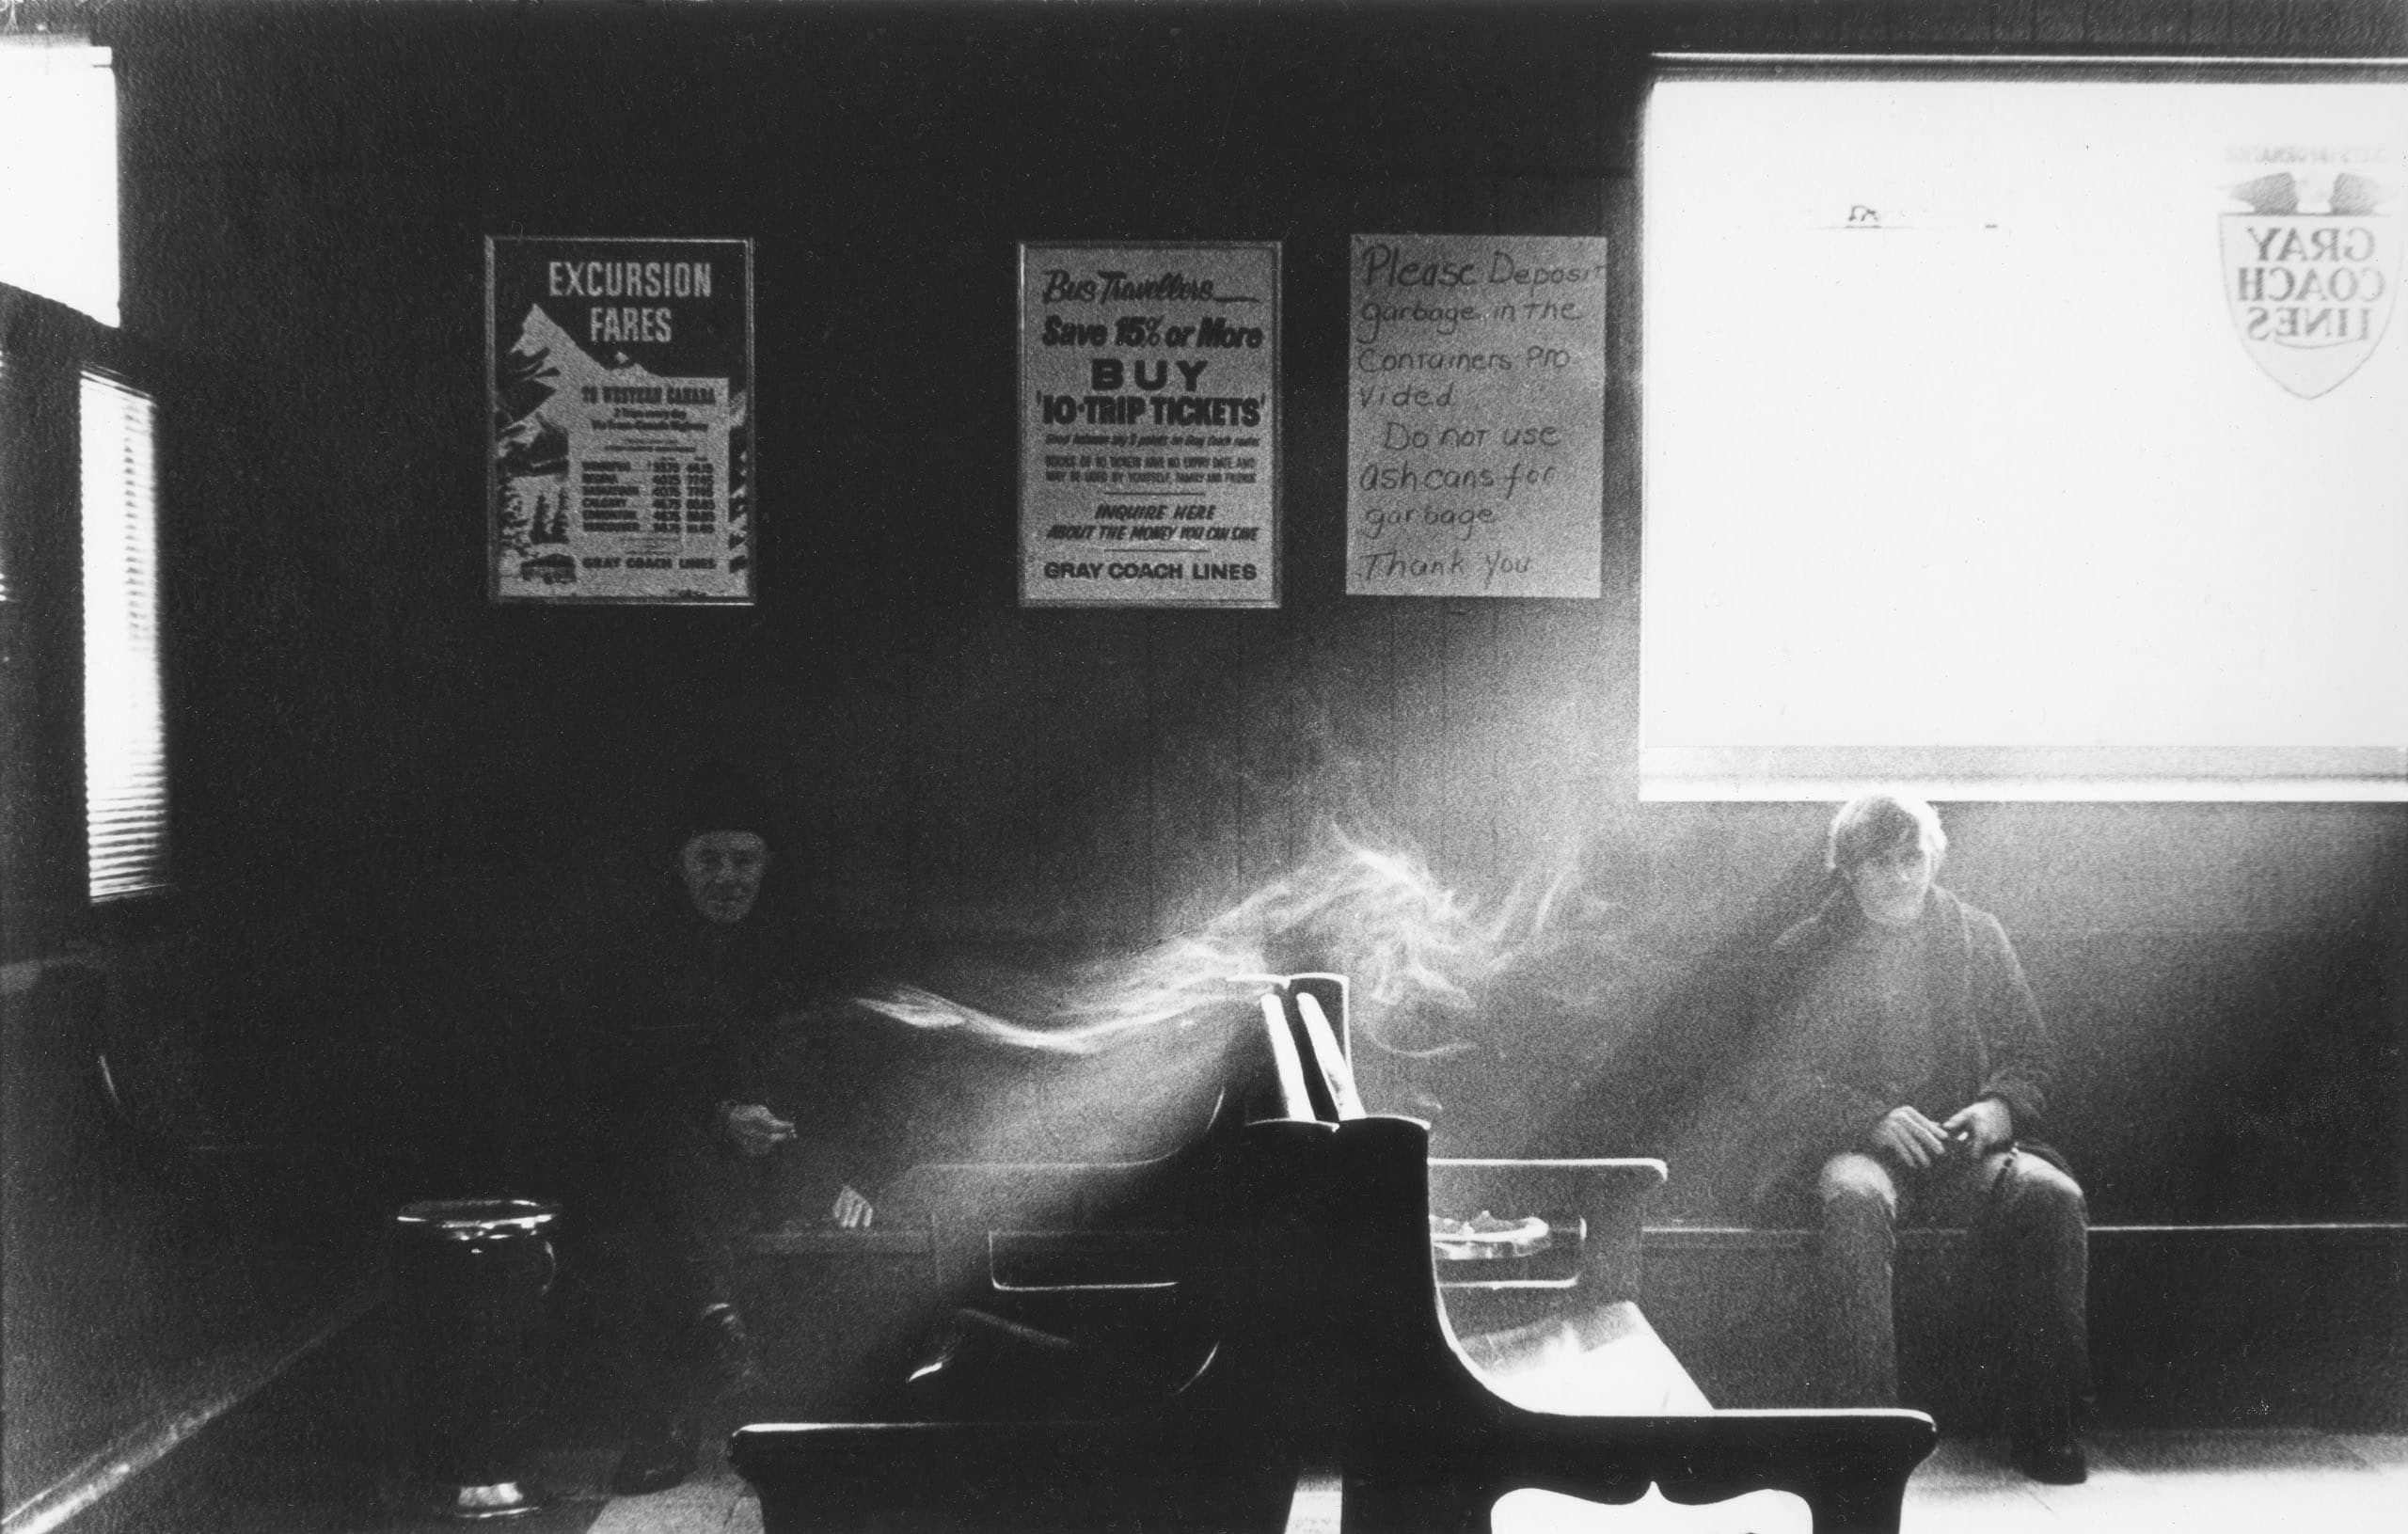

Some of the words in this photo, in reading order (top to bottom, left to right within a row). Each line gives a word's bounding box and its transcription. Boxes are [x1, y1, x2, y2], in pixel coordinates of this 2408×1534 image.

[548, 261, 712, 297] EXCURSION
[1362, 244, 1476, 287] Please
[1042, 269, 1097, 304] Bus
[1098, 270, 1214, 305] Travellers
[590, 307, 673, 342] FARES
[1042, 315, 1108, 346] Save
[1115, 315, 1165, 348] 15%
[1164, 325, 1196, 348] or
[1196, 317, 1263, 349] More
[1356, 303, 1476, 344] garbage
[1494, 303, 1516, 322] in
[1091, 358, 1208, 391] BUY
[1385, 421, 1429, 451] Do
[1503, 426, 1561, 447] use
[1506, 462, 1555, 500] for
[1094, 504, 1168, 520] INQUIRE
[1173, 504, 1216, 520] HERE
[1357, 509, 1495, 542] garbage
[1046, 525, 1097, 540] ABOUT
[1099, 525, 1127, 540] THE
[1129, 526, 1177, 541] MONEY
[1179, 527, 1205, 542] YOU
[1206, 527, 1230, 542] CAN
[1230, 526, 1260, 542] SAVE
[582, 557, 622, 568] GRAY
[626, 557, 673, 569] COACH
[1043, 562, 1104, 579] GRAY
[1107, 562, 1183, 579] COACH
[1192, 563, 1259, 580] LINES
[1360, 550, 1464, 581] Thank
